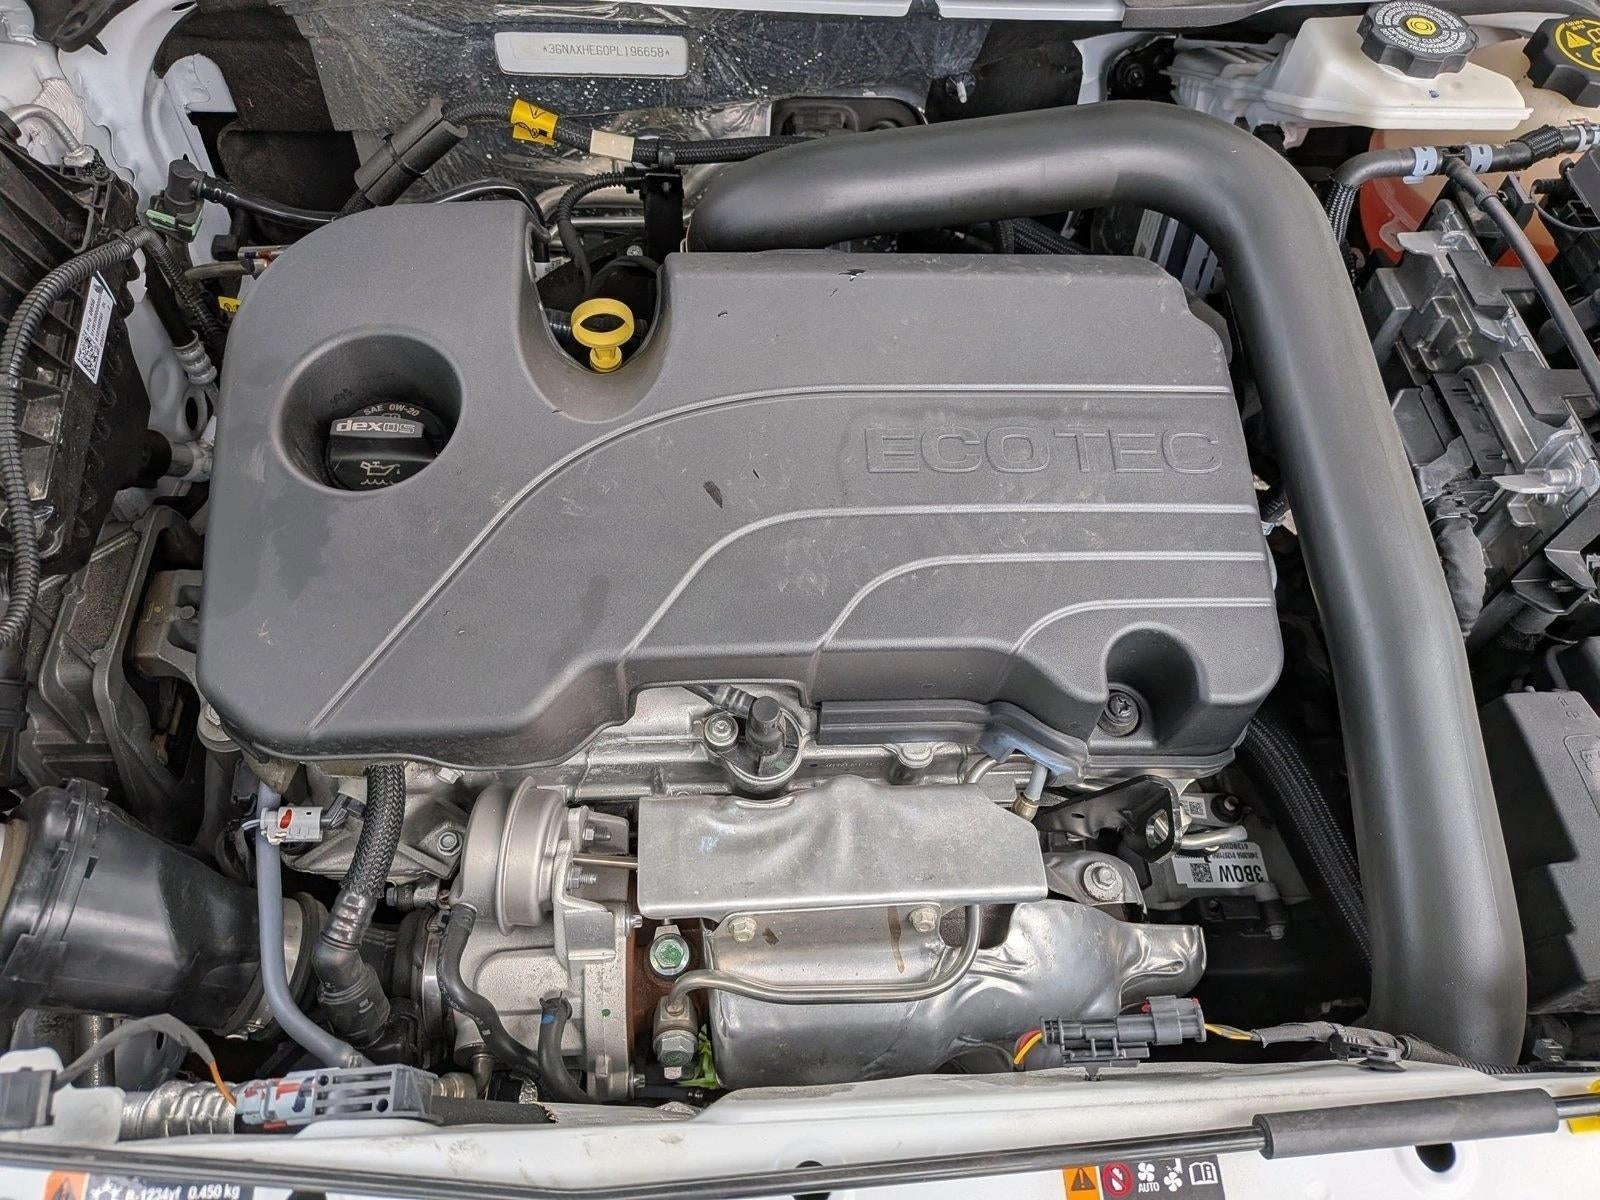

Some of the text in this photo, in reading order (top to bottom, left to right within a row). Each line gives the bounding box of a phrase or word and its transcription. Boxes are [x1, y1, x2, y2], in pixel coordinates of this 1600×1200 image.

[1408, 44, 1428, 53] FROM
[363, 403, 420, 417] SAE 0W-20
[336, 419, 416, 434] dexos
[864, 427, 1223, 474] ECOTEC
[1219, 864, 1264, 883] 3BQW
[223, 1183, 240, 1200] kg
[1138, 1181, 1160, 1193] AUTO
